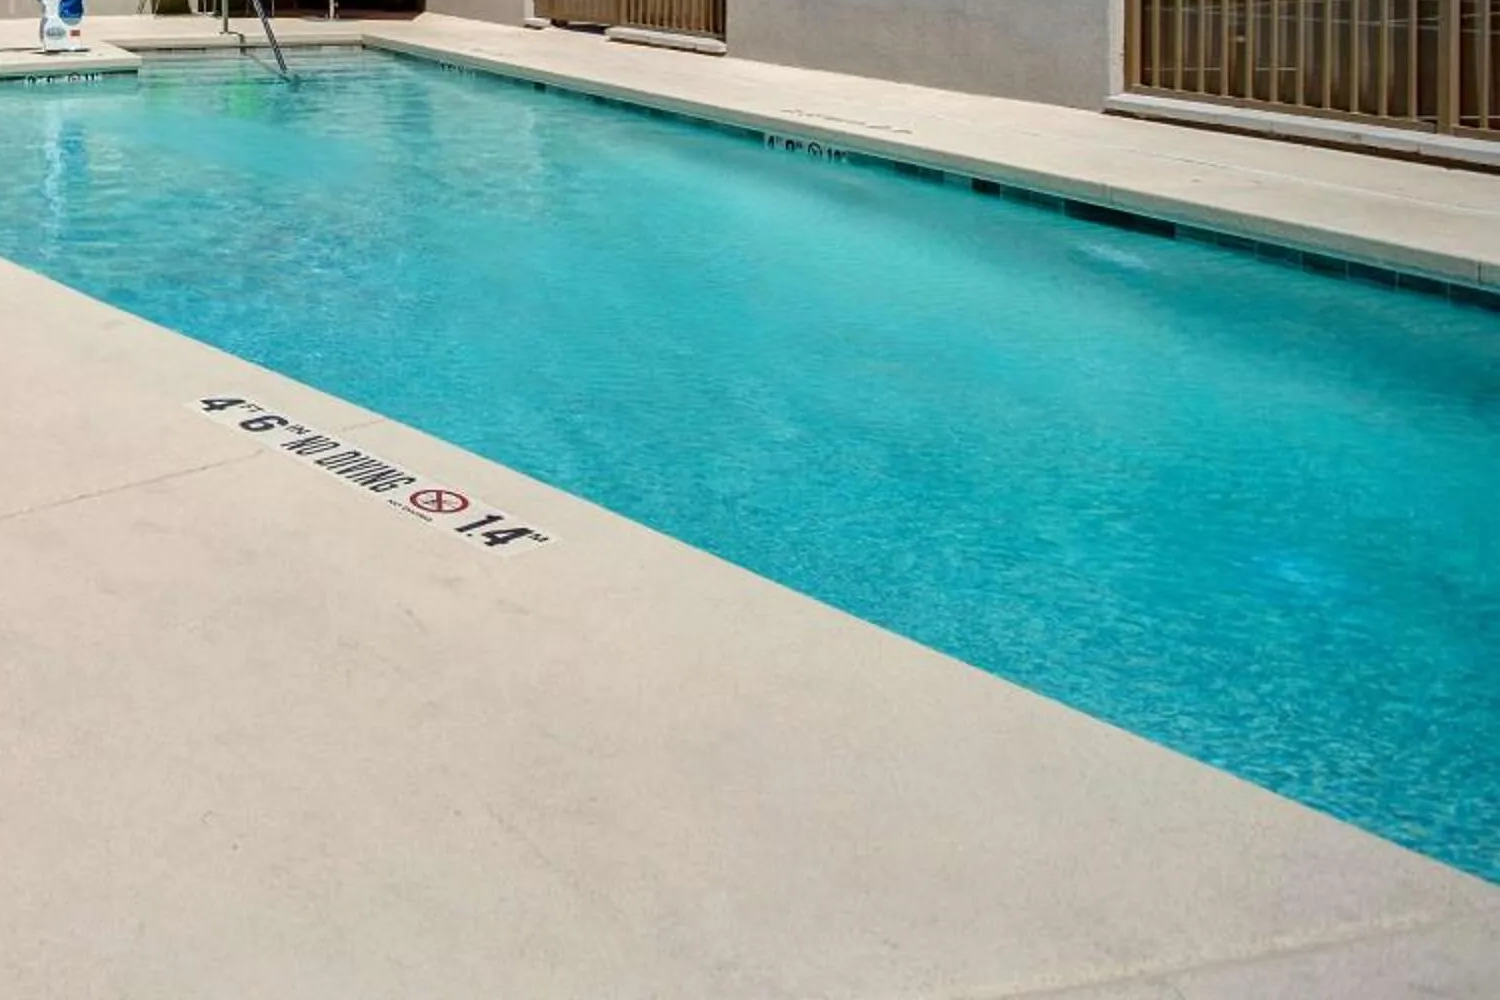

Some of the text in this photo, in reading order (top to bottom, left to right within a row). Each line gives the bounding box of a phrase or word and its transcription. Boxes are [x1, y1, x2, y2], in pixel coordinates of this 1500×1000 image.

[200, 397, 246, 412] 4
[239, 415, 289, 432] 6
[280, 435, 341, 456] NO
[314, 449, 416, 493] DIVING
[454, 514, 535, 547] 1.4
